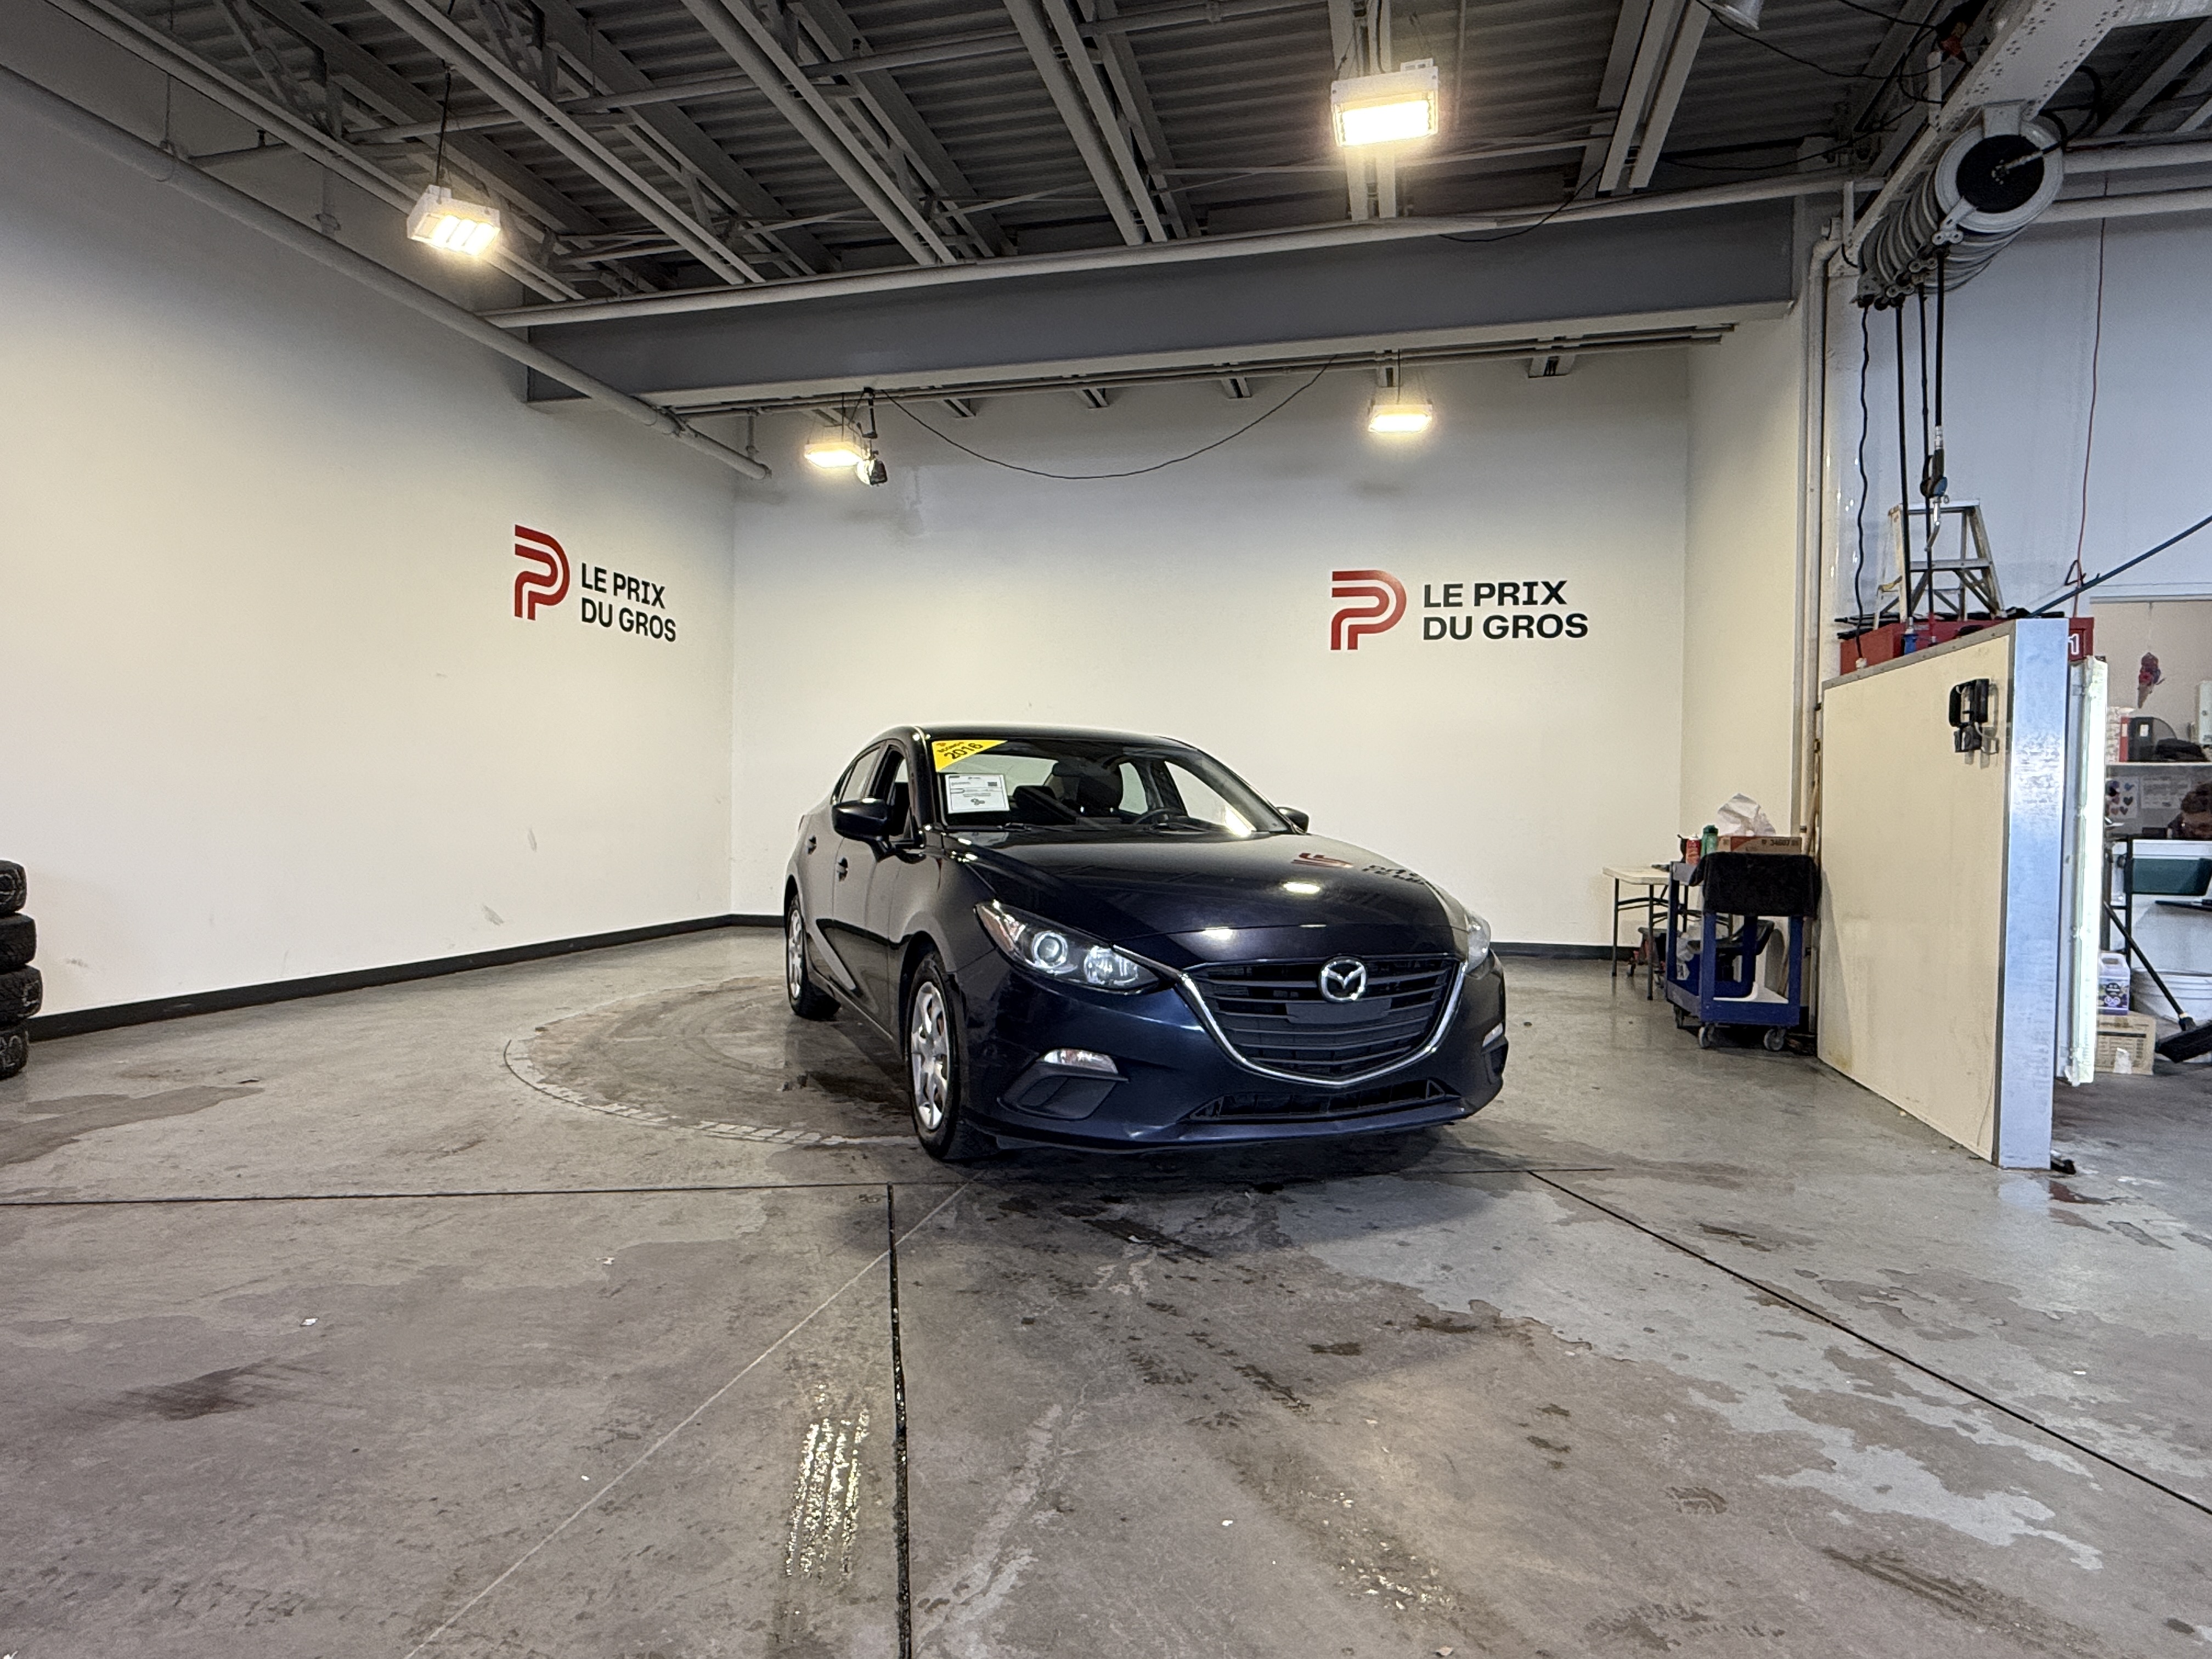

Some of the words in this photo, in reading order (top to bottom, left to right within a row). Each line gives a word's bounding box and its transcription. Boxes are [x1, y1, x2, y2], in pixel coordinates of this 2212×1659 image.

[582, 562, 607, 594] LE
[613, 572, 666, 610] PRIX
[1424, 583, 1464, 608] LE
[1474, 580, 1567, 607] PRIX
[582, 597, 613, 628] DU
[619, 607, 676, 642] GROS
[1423, 616, 1472, 640] DU
[1482, 613, 1588, 640] GROS
[944, 742, 984, 760] 2016
